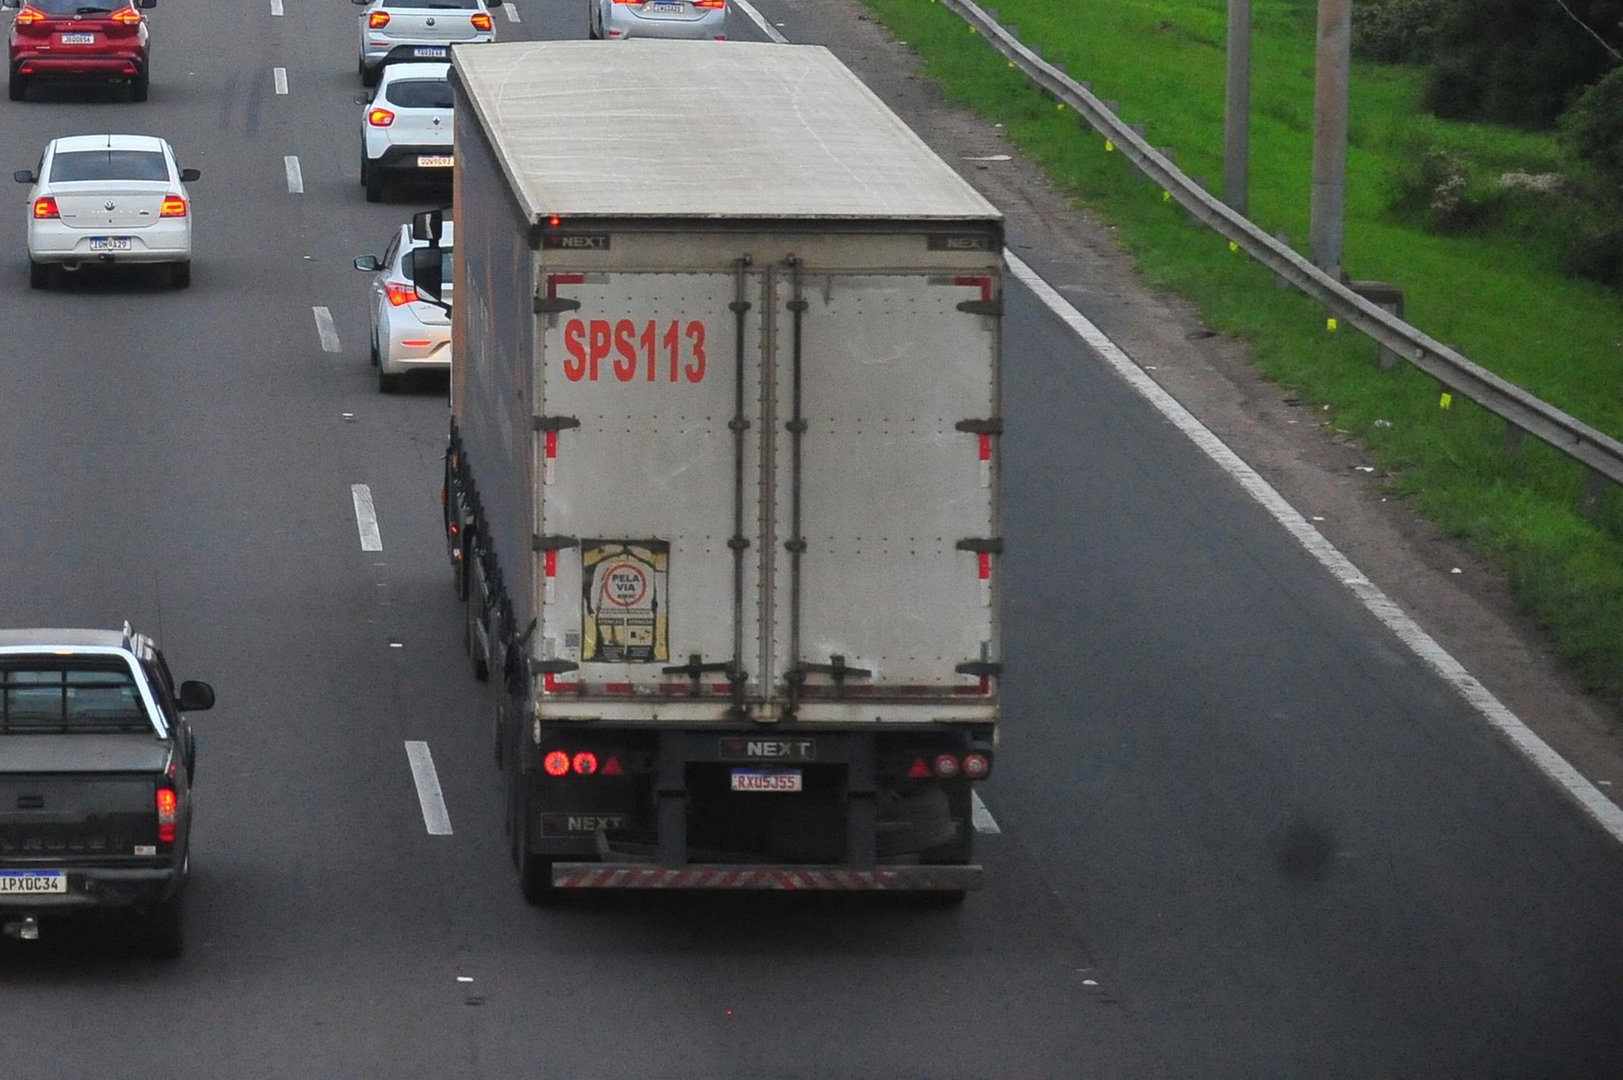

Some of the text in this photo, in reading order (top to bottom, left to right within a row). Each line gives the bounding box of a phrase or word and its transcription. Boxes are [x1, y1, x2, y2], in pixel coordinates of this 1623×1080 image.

[562, 237, 606, 247] NEXT
[563, 319, 707, 383] SPS113
[612, 574, 640, 583] PELA
[747, 742, 811, 756] NEXT
[568, 816, 622, 831] NEXT
